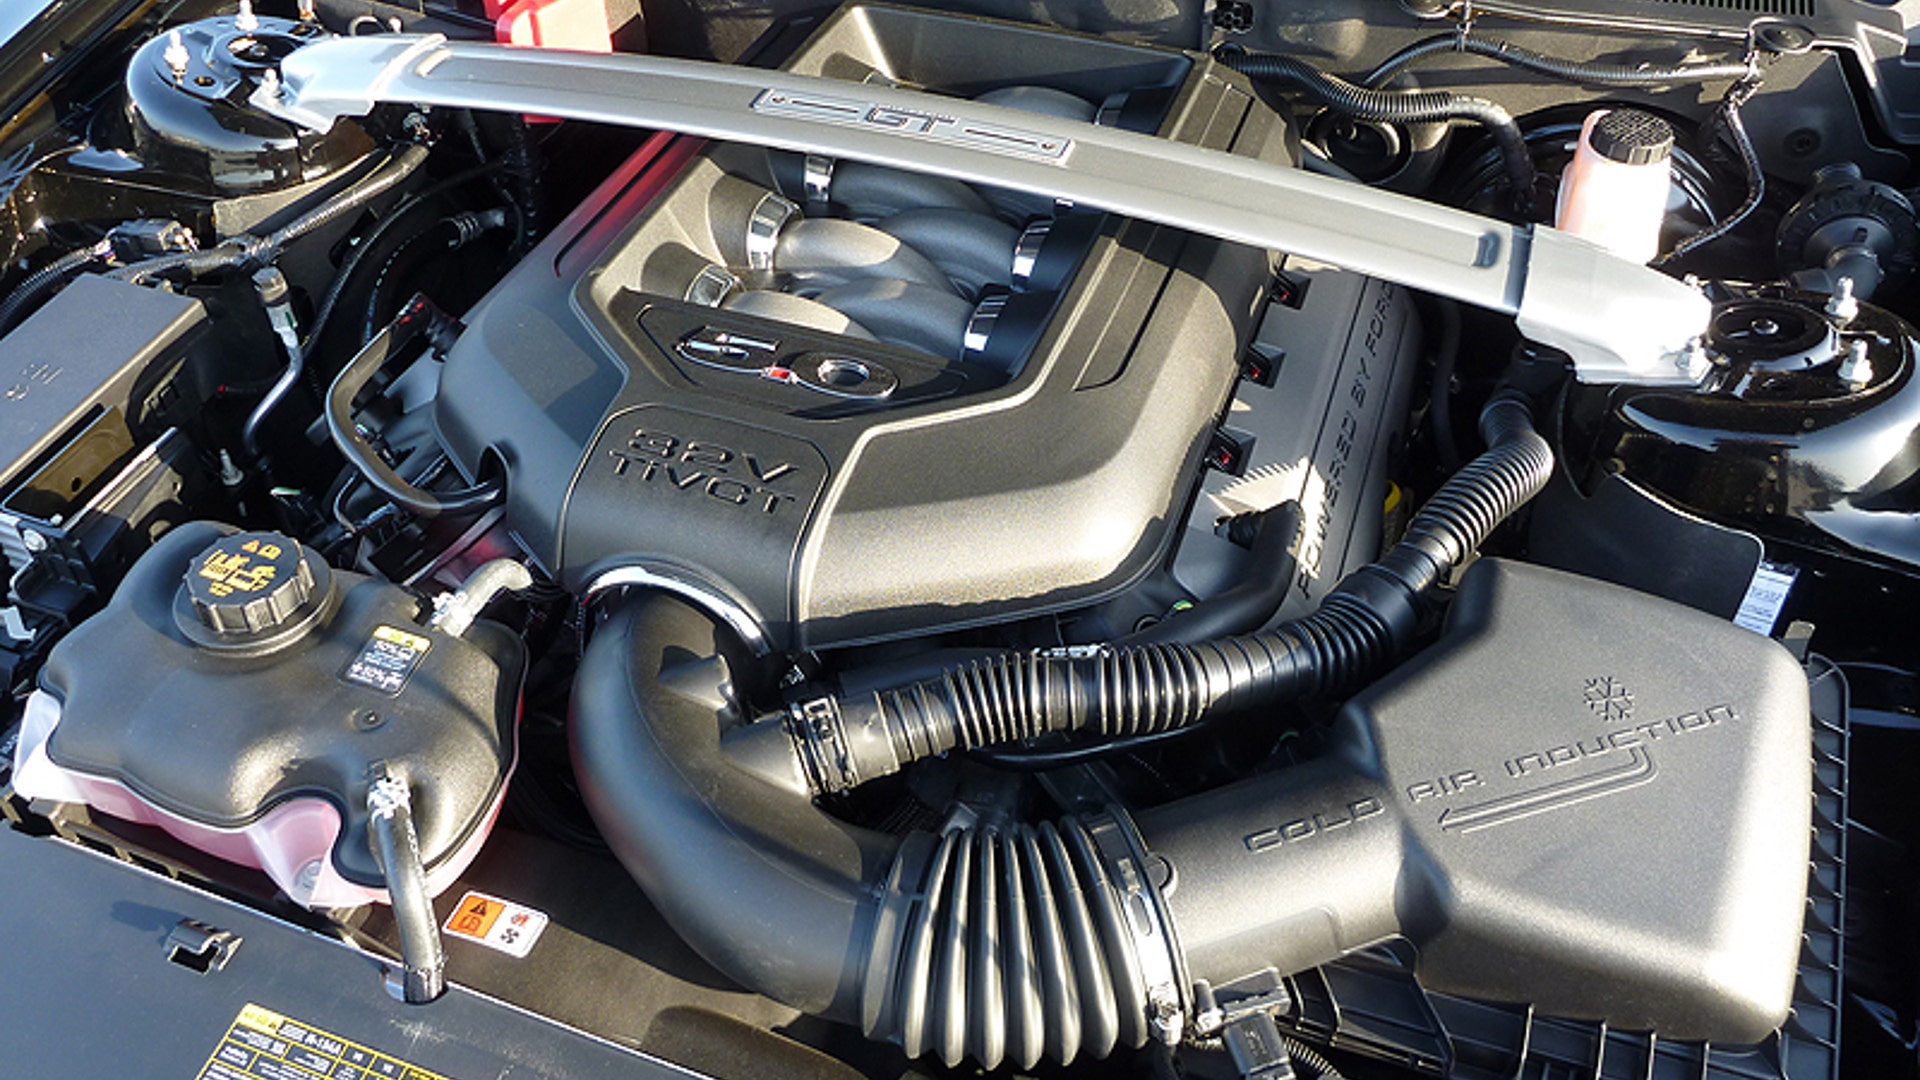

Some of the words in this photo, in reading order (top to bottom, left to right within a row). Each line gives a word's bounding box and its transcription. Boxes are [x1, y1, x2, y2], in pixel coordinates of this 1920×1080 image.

[865, 103, 957, 133] GT
[1351, 356, 1371, 409] BY
[628, 428, 800, 483] 32V
[1243, 796, 1386, 854] COLD
[1407, 769, 1486, 802] AIR
[1504, 703, 1740, 778] INDUCTION
